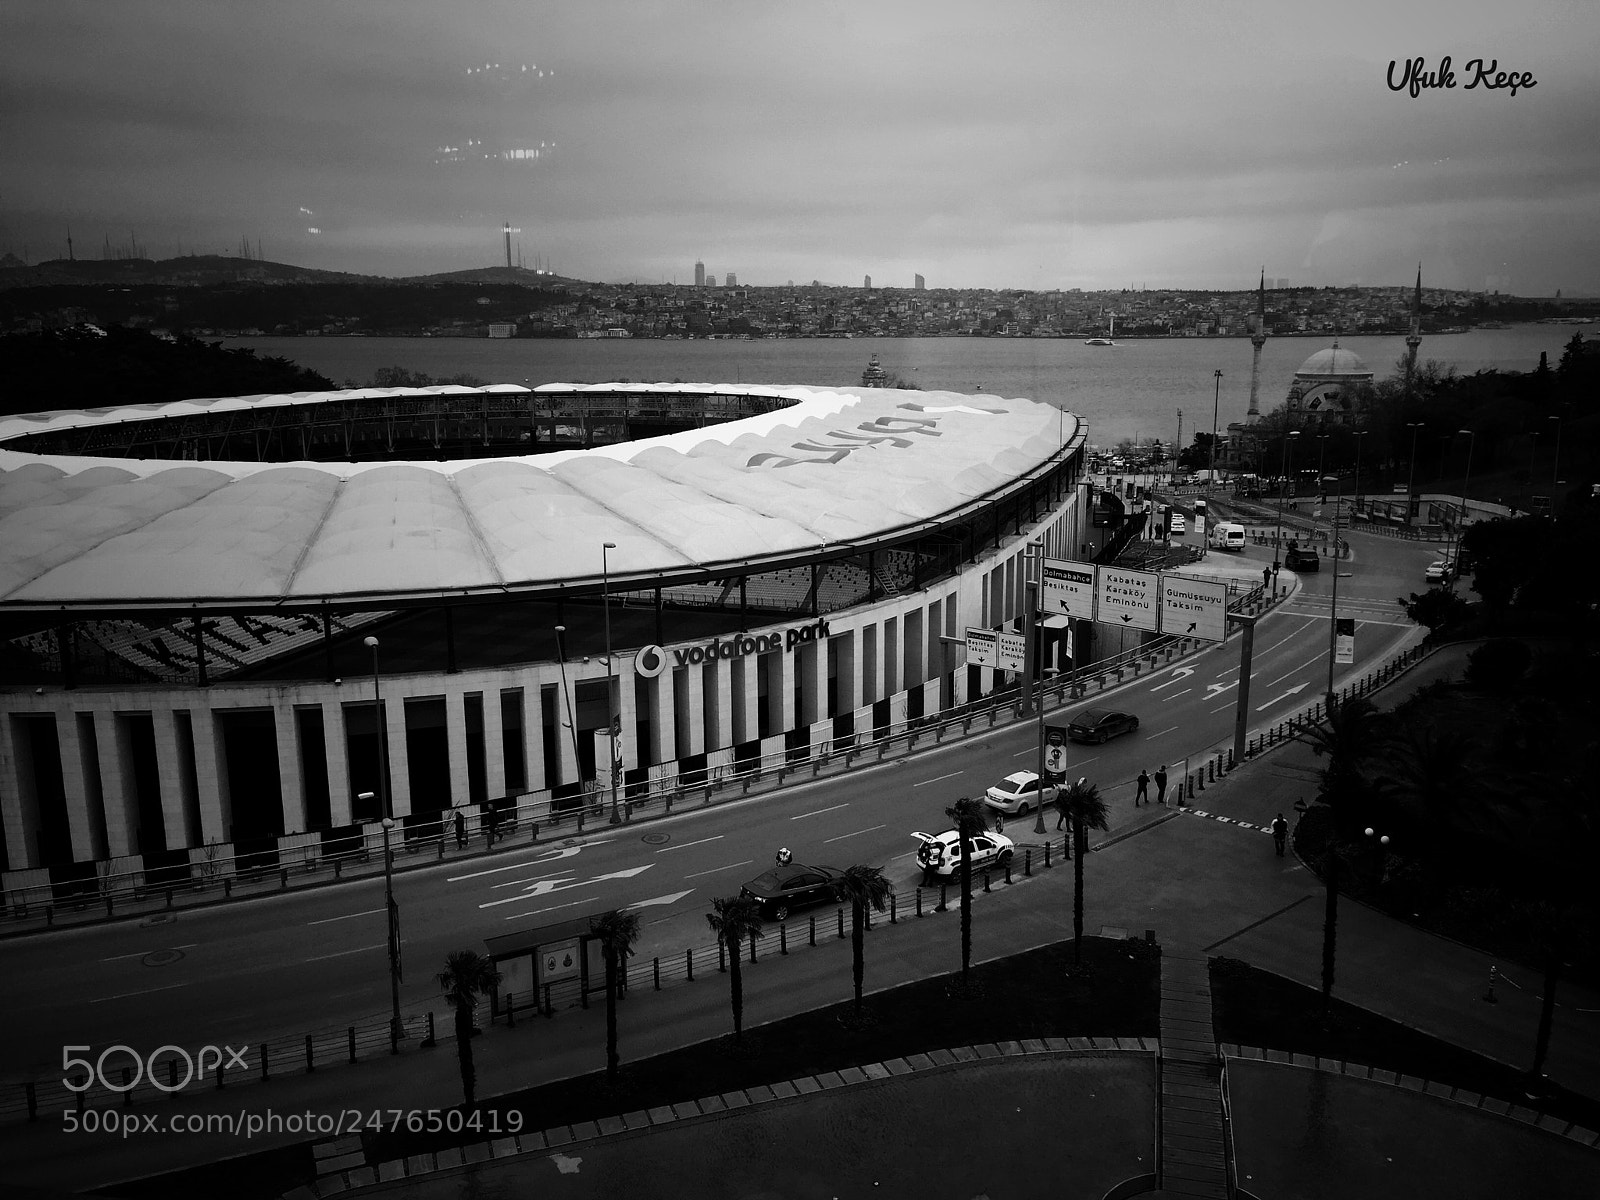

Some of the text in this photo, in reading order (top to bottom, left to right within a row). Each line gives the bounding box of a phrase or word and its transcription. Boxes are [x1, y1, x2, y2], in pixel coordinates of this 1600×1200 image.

[1043, 581, 1078, 593] Beşiktaş
[1106, 574, 1147, 588] Kabataş
[1106, 585, 1146, 599] Karaköy
[1166, 588, 1222, 604] Gümüşsuyu
[1106, 596, 1149, 609] Eminönü
[1166, 600, 1204, 612] Taksim
[673, 617, 830, 666] vodafone park
